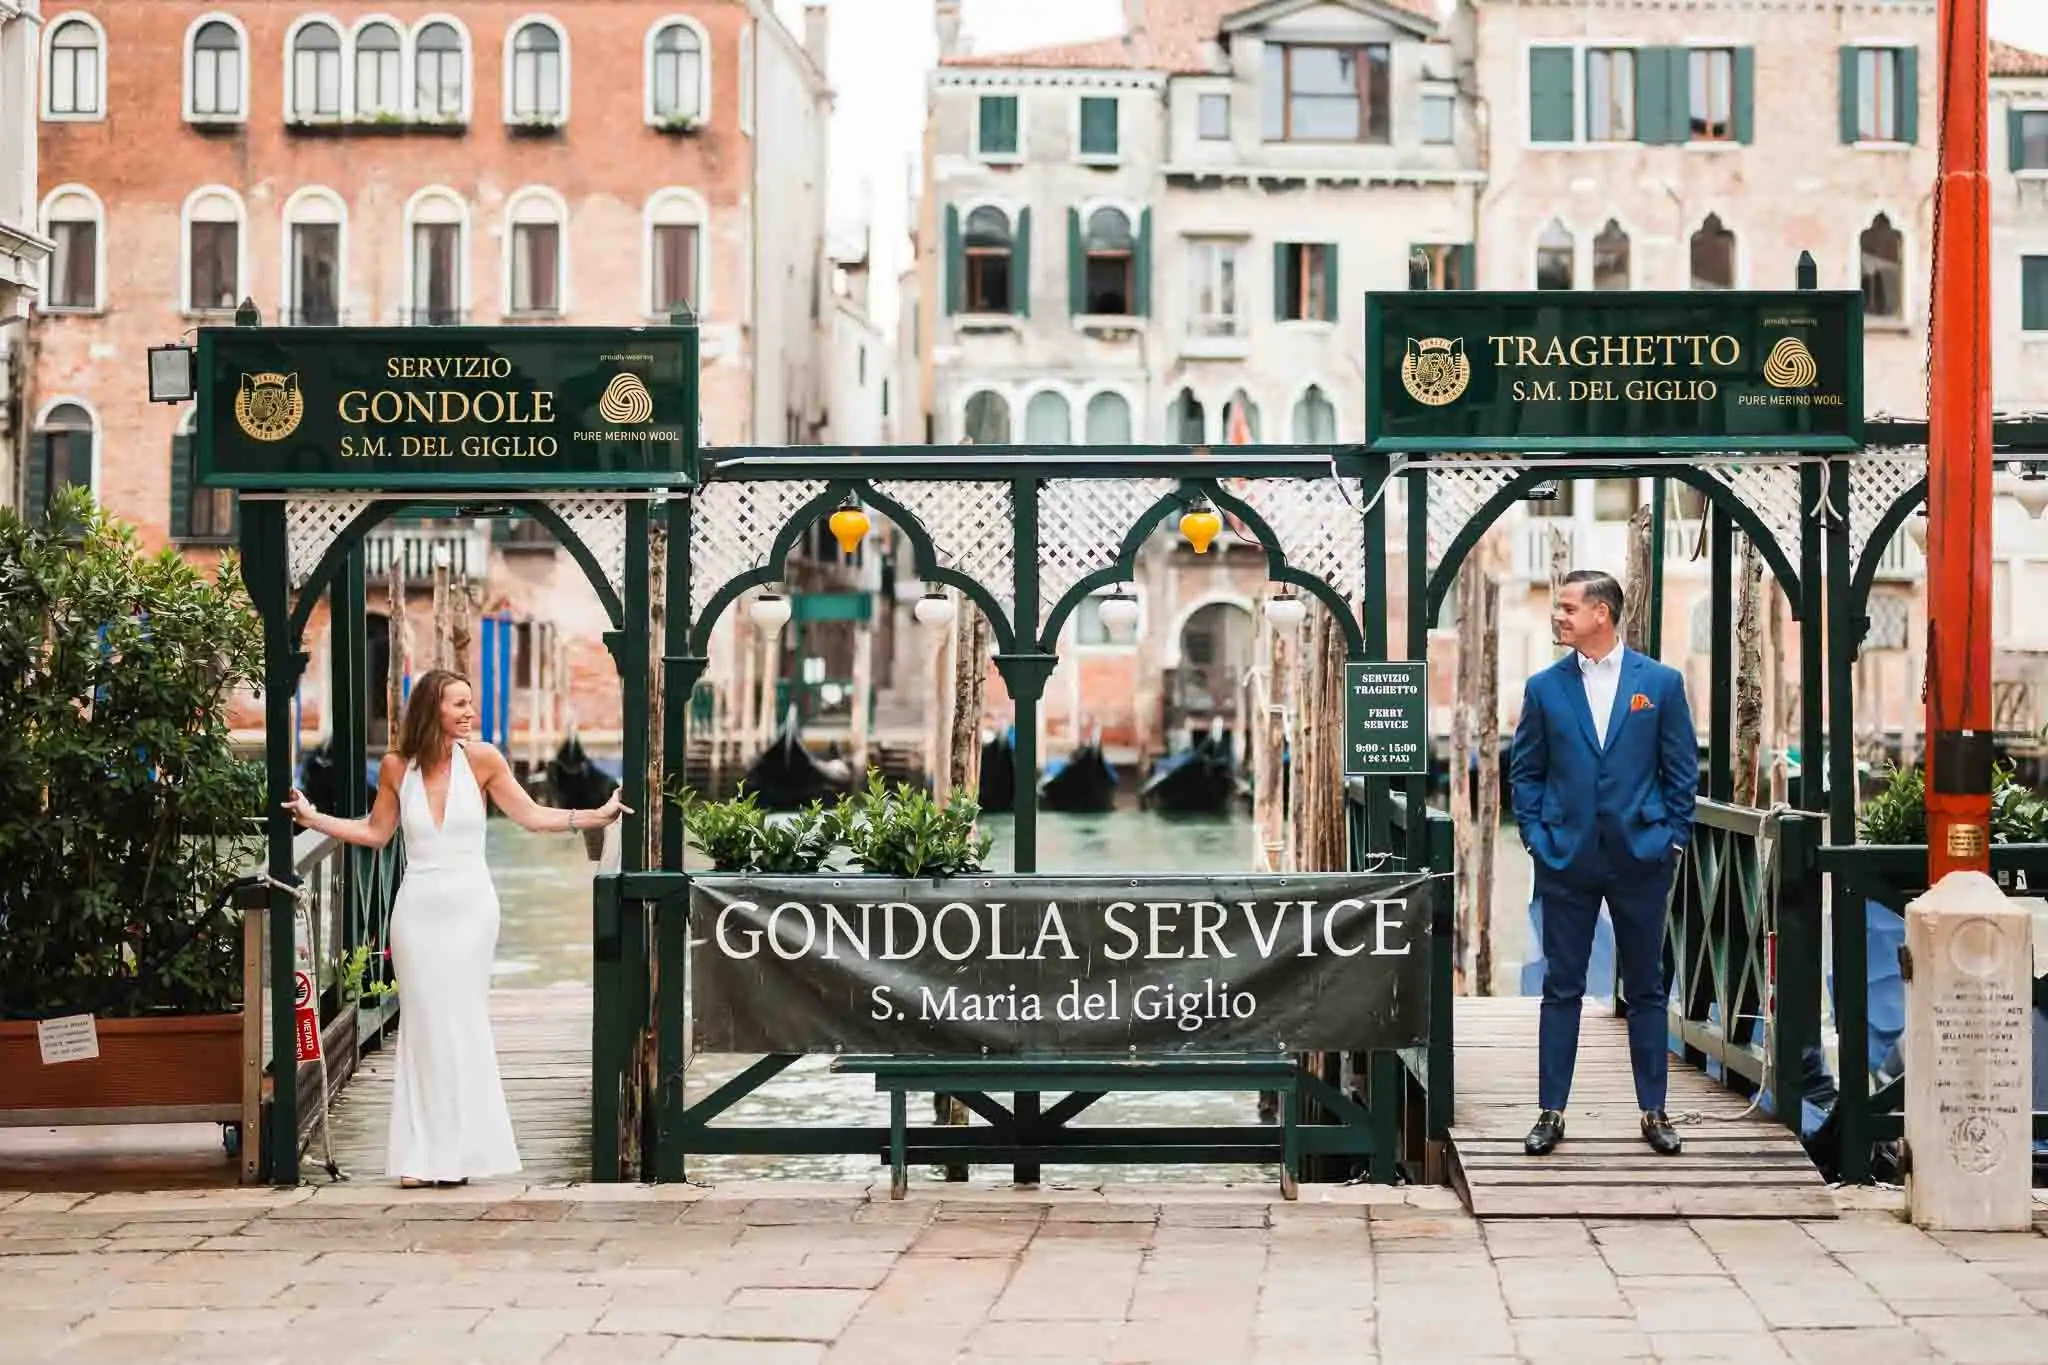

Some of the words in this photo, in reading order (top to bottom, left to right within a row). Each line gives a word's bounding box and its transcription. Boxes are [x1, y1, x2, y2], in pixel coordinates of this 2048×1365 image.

[1488, 335, 1741, 367] TRAGHETTO
[386, 357, 512, 378] SERVIZIO
[1512, 380, 1561, 401] S.M.
[1568, 380, 1619, 401] DEL
[1625, 380, 1718, 402] GIGLIO
[1738, 395, 1767, 406] PURE
[1769, 395, 1812, 406] MERINO
[1814, 395, 1844, 406] WOOL
[338, 390, 556, 423] GONDOLE
[340, 436, 392, 457] S.M.
[401, 436, 454, 457] DEL
[461, 436, 558, 457] GIGLIO
[573, 431, 602, 441] PURE
[605, 431, 647, 441] MERINO
[649, 431, 680, 441] WOOL
[1361, 673, 1410, 683] SERVIZIO
[1354, 685, 1418, 695] TRAGHETTO
[1368, 708, 1404, 718] FERRY
[1363, 720, 1409, 729] SERVICE
[1355, 743, 1379, 753] 9:00
[1388, 743, 1417, 753] 15:00
[715, 900, 1080, 962] GONDOLA
[1103, 898, 1411, 960] SERVICE
[870, 985, 905, 1021] S.
[919, 984, 1035, 1022] Maria
[1056, 979, 1120, 1021] del
[1132, 981, 1257, 1031] Giglio
[303, 1018, 314, 1051] VIETATO
